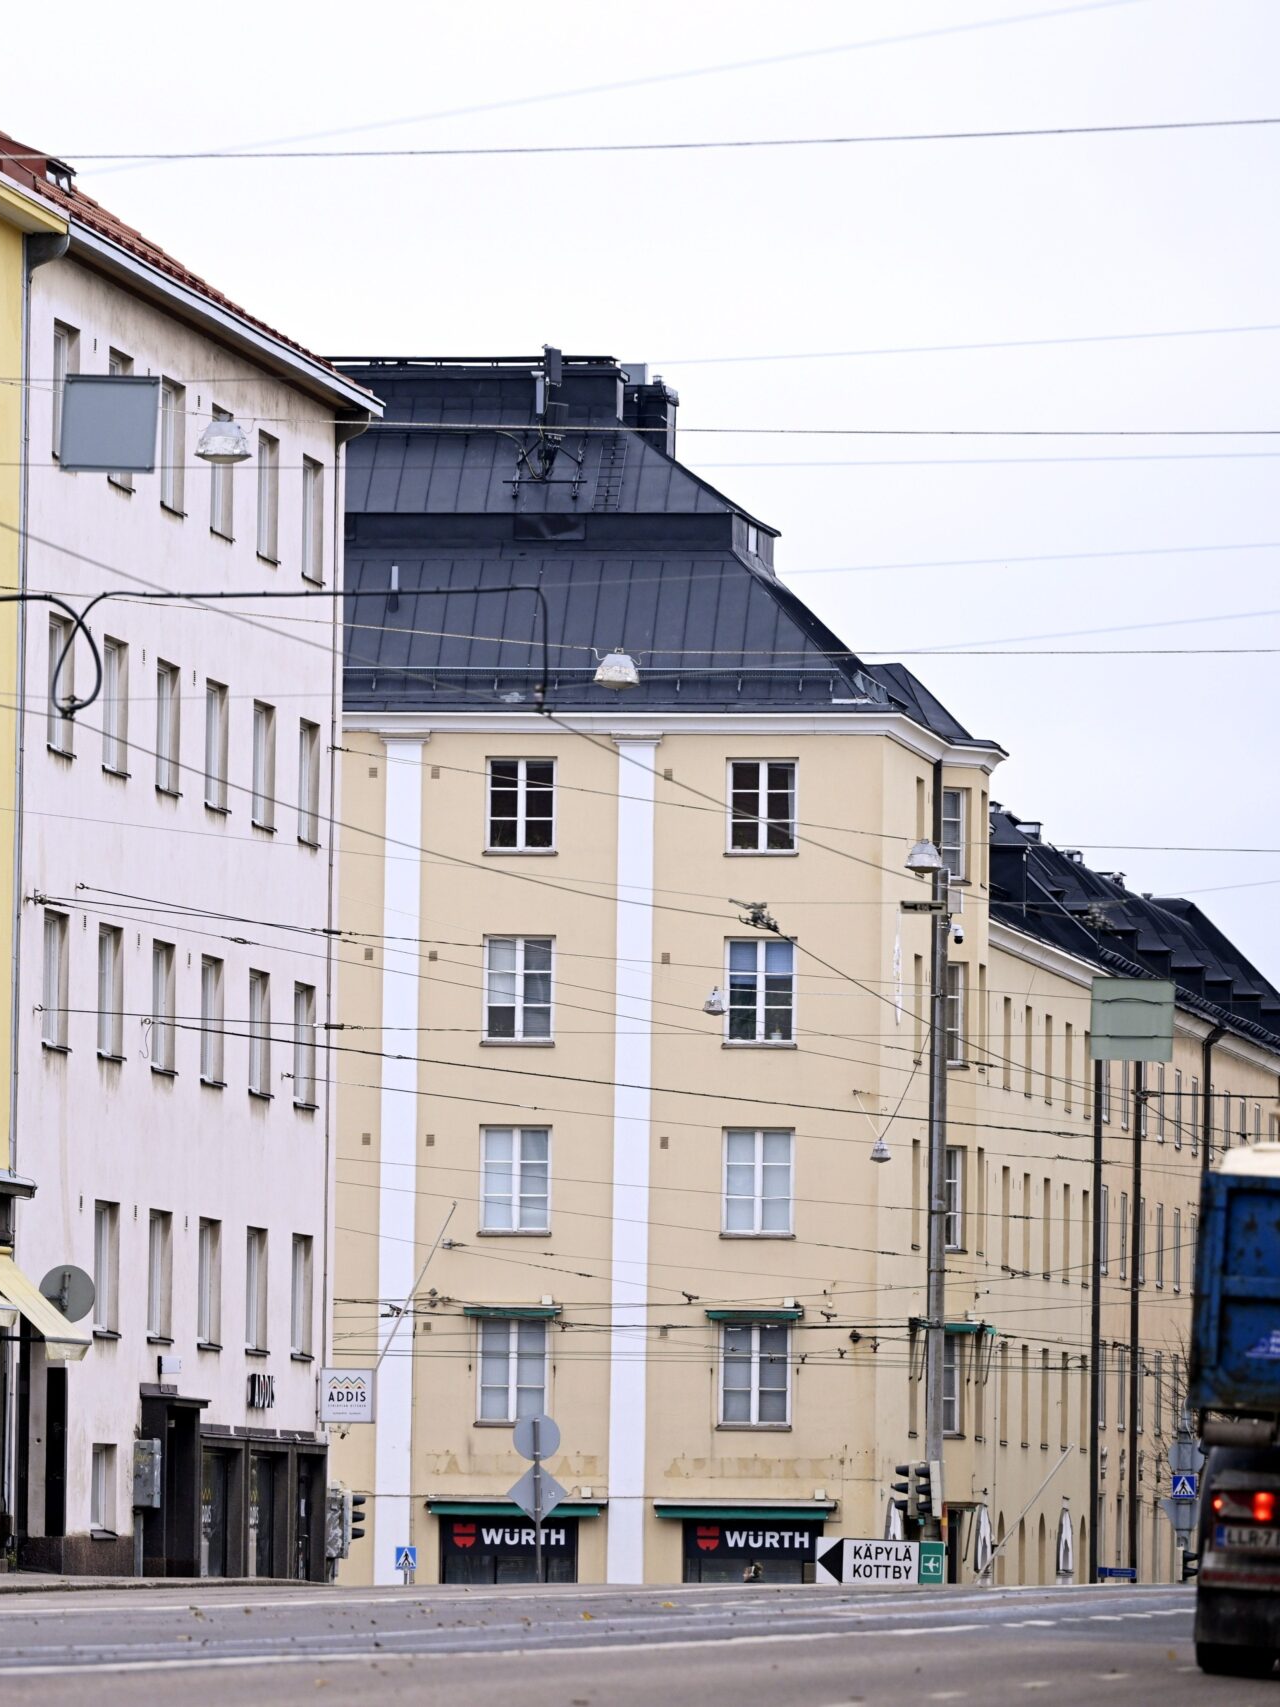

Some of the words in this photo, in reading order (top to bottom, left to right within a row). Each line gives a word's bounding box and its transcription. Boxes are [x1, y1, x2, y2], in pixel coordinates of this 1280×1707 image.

[328, 1391, 366, 1402] ADDIS
[852, 1544, 913, 1562] KÄPYLÄ
[852, 1563, 913, 1580] KOTTBY
